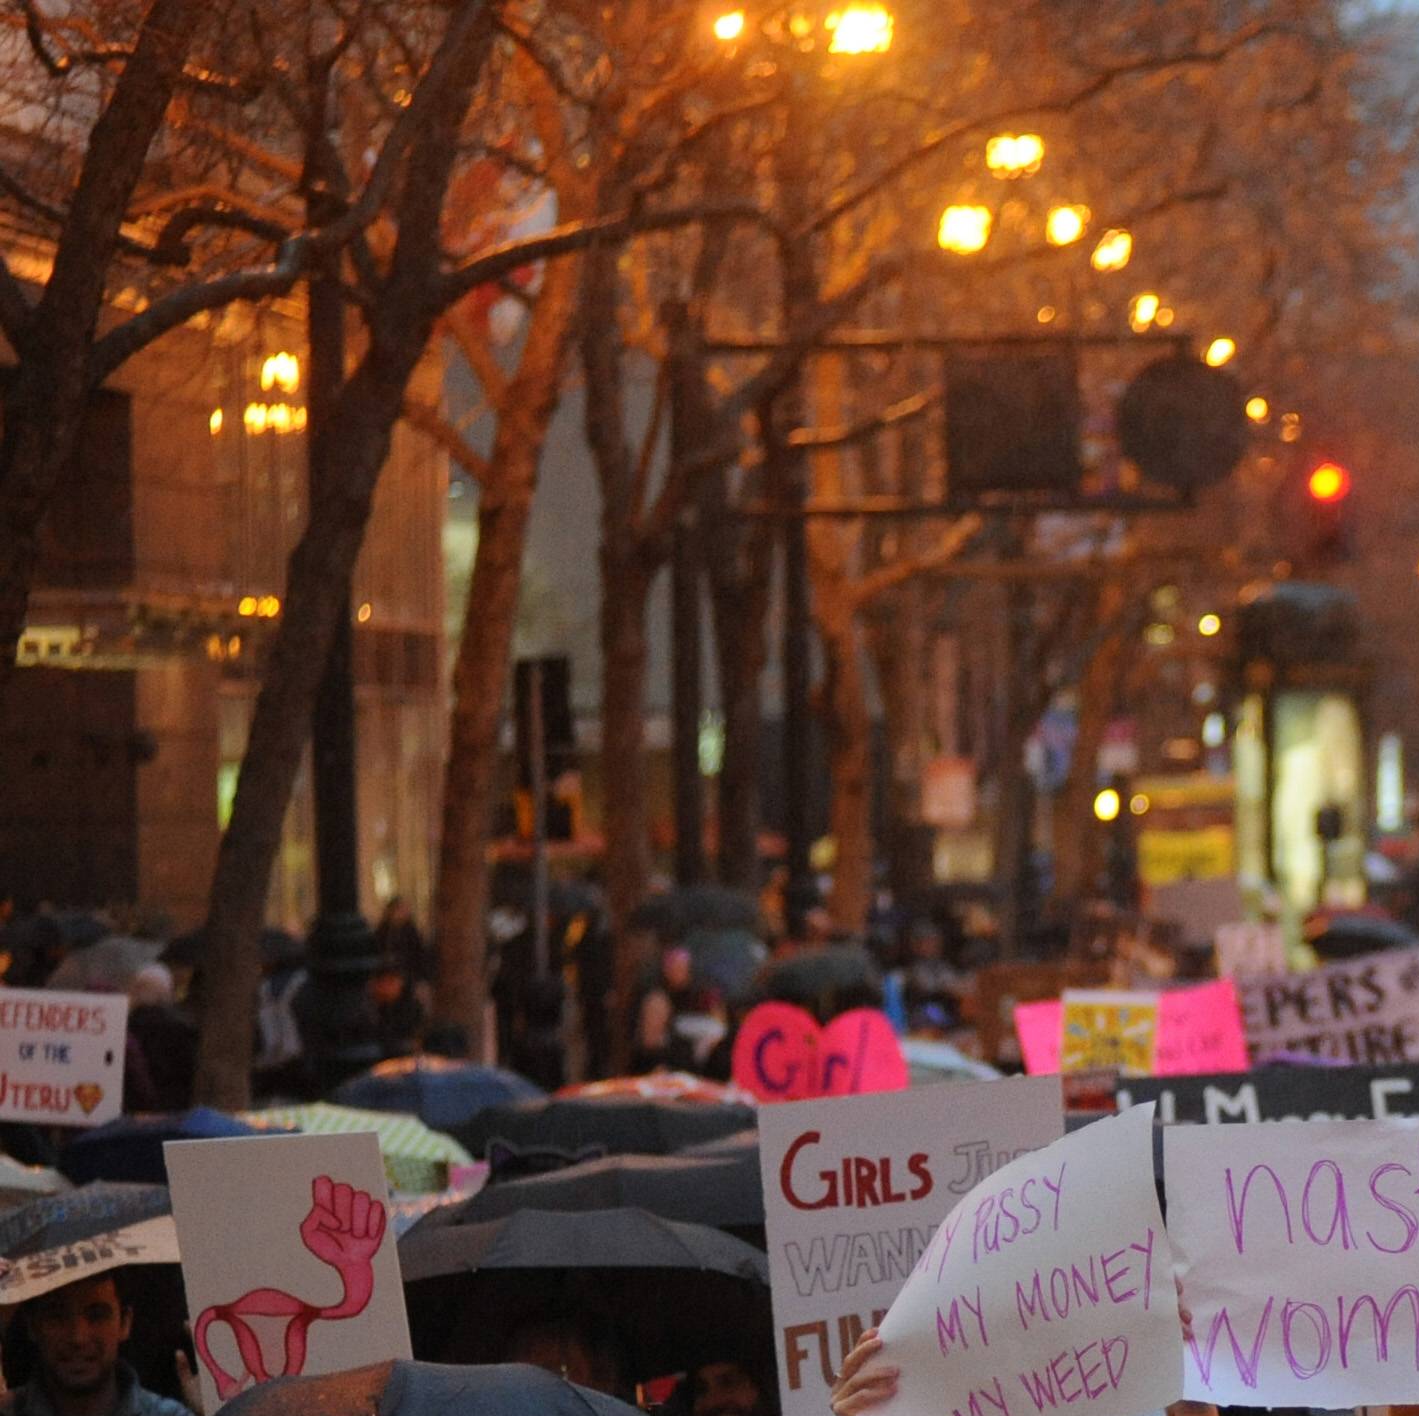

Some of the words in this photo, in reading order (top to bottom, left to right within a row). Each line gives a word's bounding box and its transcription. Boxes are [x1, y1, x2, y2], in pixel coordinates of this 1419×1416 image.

[0, 1002, 107, 1035] EFENDERS
[1242, 962, 1388, 1032] EPERS
[935, 1287, 989, 1358] MY
[1015, 1228, 1154, 1331] MONEY
[1018, 1335, 1129, 1414] WEED
